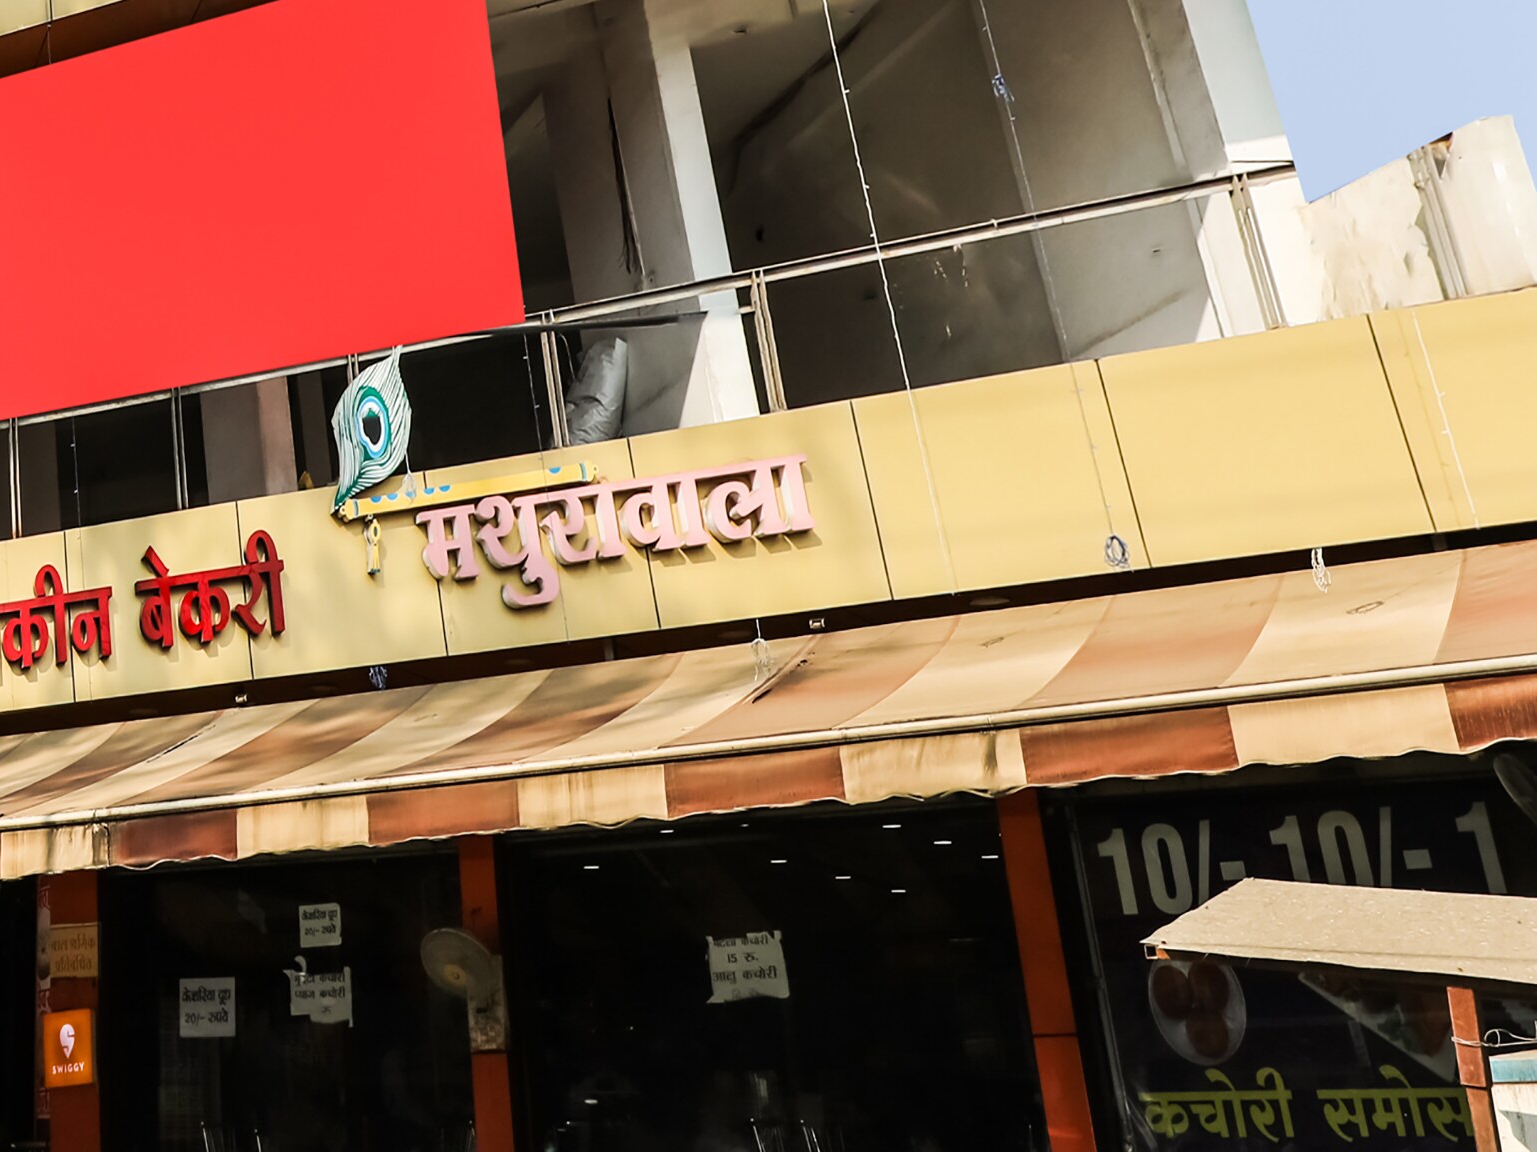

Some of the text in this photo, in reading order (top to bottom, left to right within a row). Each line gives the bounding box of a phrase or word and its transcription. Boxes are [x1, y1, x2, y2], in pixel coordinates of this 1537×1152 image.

[416, 454, 816, 611] मथुरावाला
[135, 529, 285, 650] बेकरी
[1098, 820, 1247, 915] 10/-
[727, 953, 737, 964] 15
[185, 1012, 206, 1027] 20/-
[52, 1061, 85, 1075] SWIGGY
[1139, 1066, 1295, 1143] कचोरी
